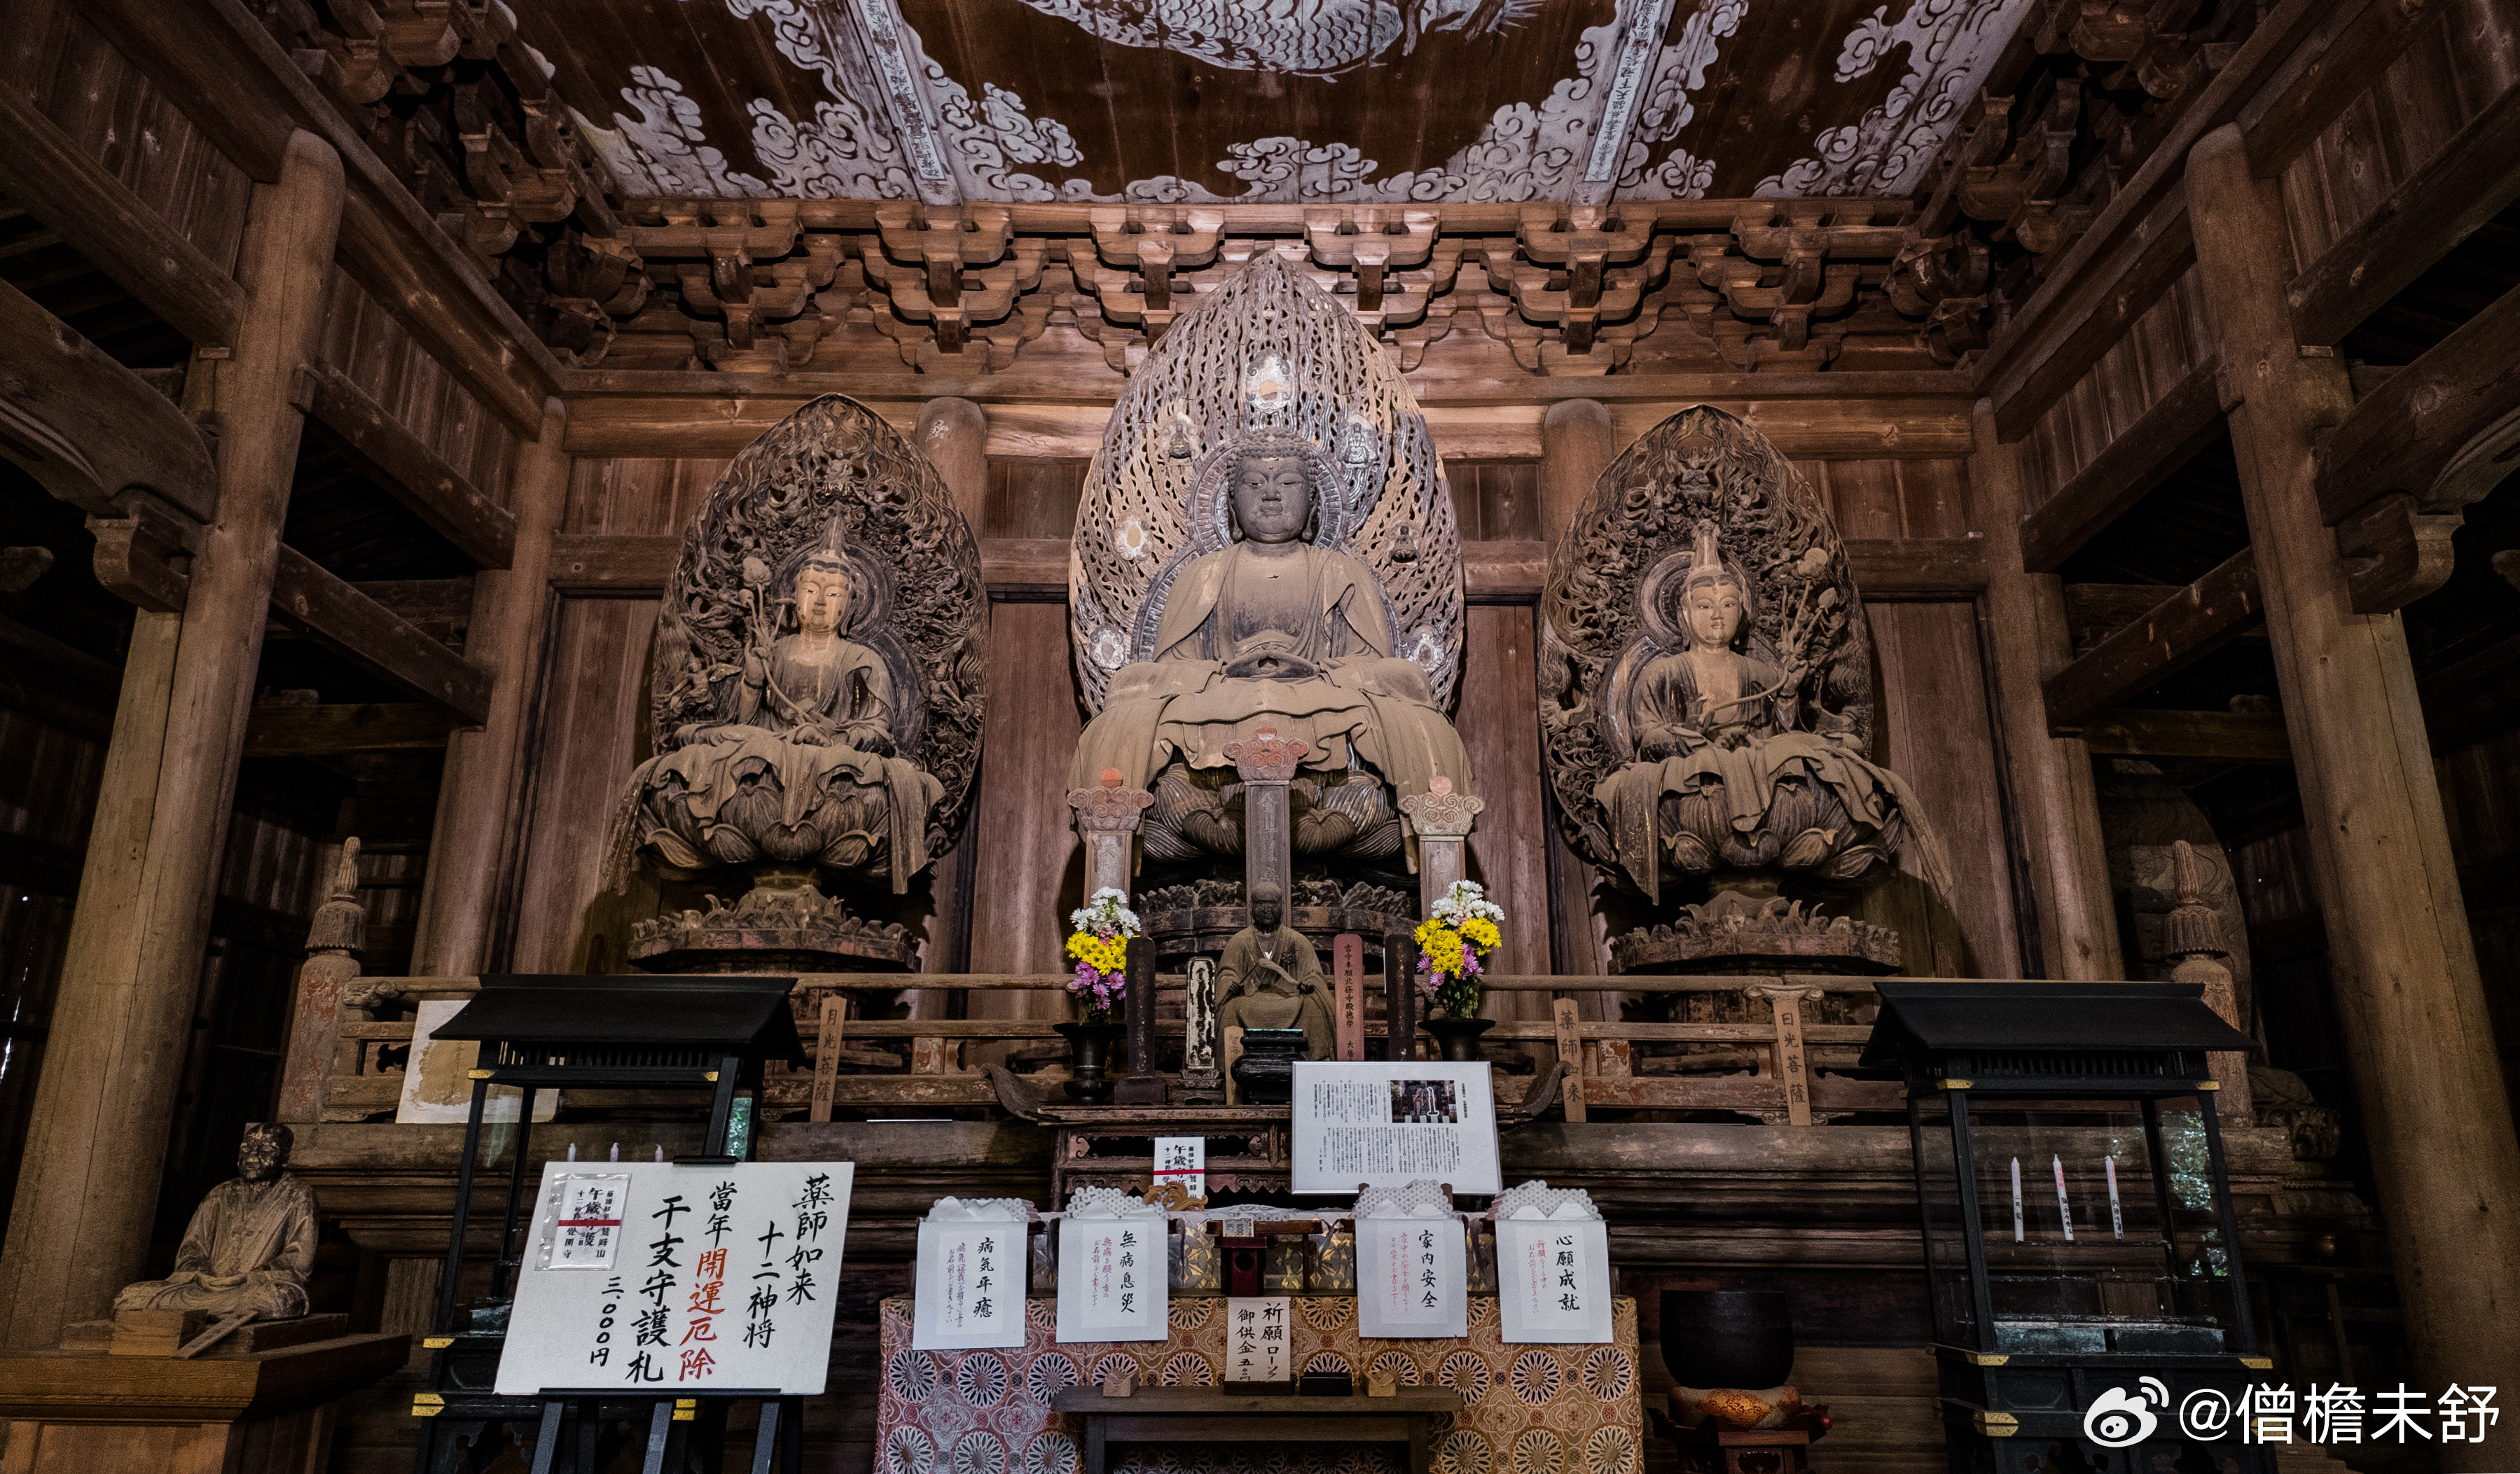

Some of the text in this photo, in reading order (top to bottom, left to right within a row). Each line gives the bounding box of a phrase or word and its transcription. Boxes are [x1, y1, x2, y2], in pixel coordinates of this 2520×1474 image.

[815, 1008, 838, 1102] 月光菩薩
[1345, 1040, 1355, 1061] 大居
[1781, 1012, 1807, 1104] 日光菩薩
[785, 1171, 835, 1306] 薬師如来
[973, 1237, 995, 1319] 病気平癒
[1119, 1230, 1137, 1314] 無病息災
[1418, 1229, 1438, 1308] 家内安全
[1556, 1235, 1581, 1312] 心願成就
[625, 1195, 692, 1384] 干支守護札
[742, 1221, 784, 1349] 十二神将
